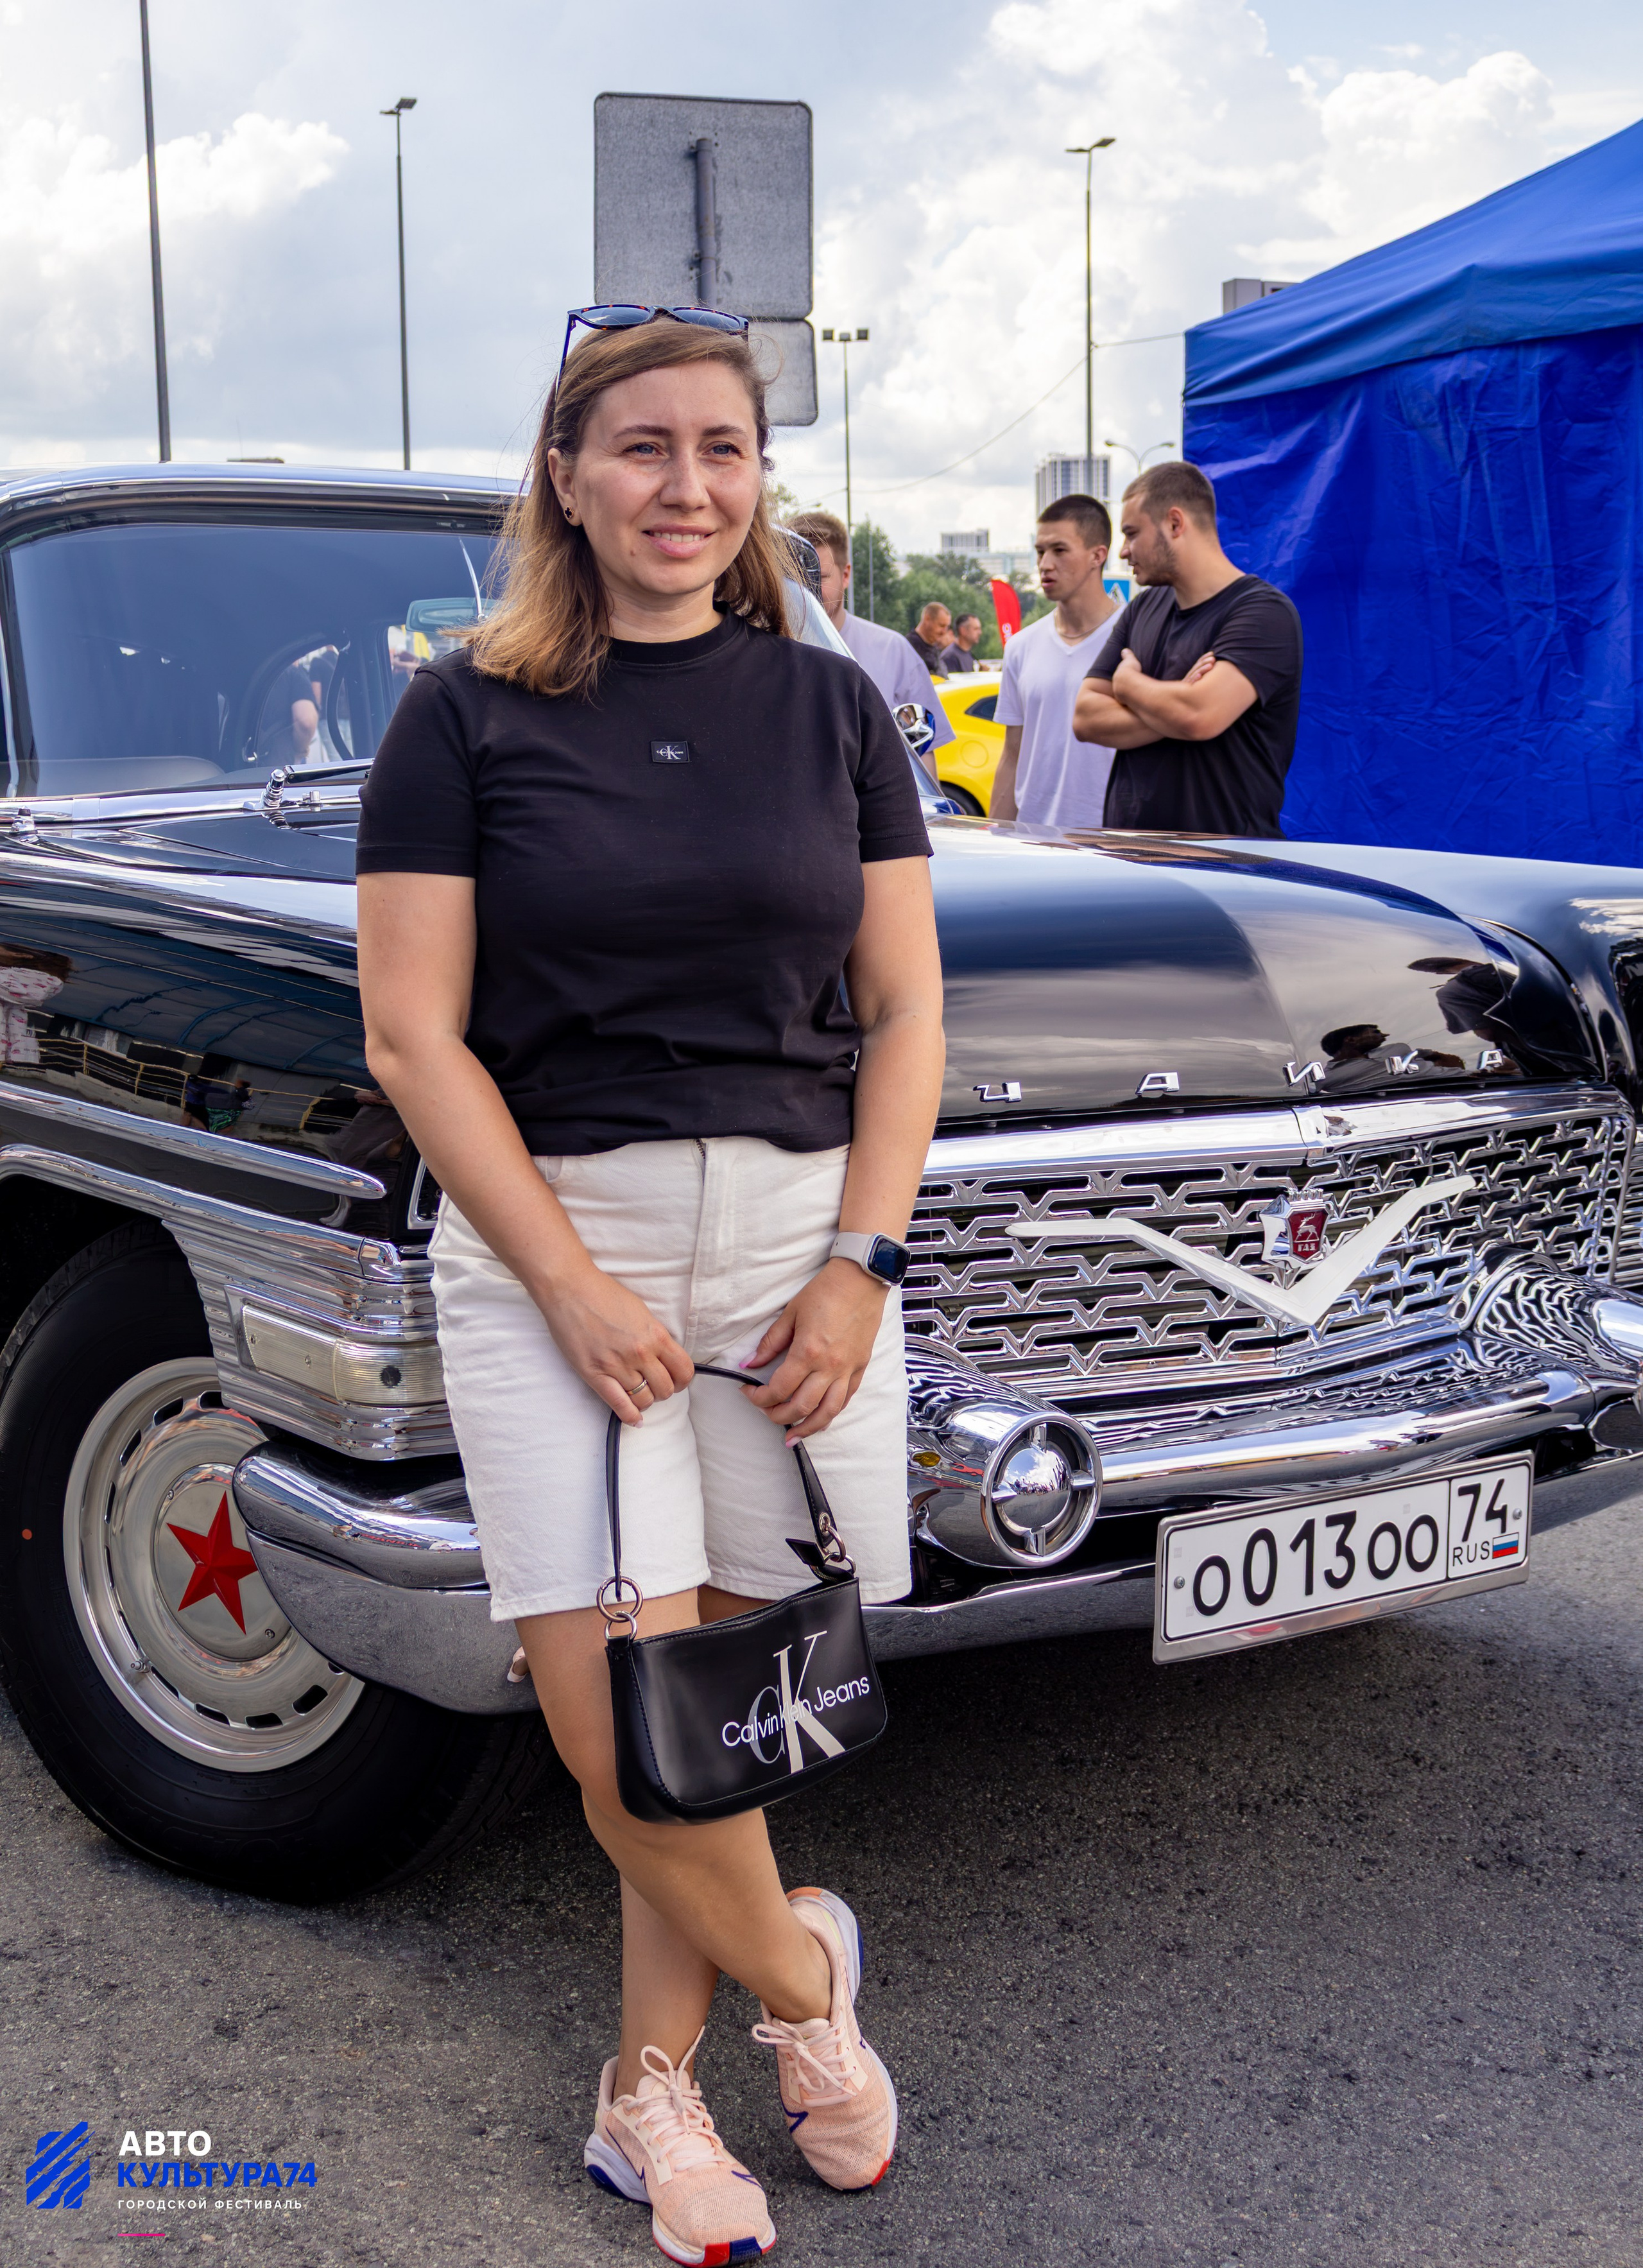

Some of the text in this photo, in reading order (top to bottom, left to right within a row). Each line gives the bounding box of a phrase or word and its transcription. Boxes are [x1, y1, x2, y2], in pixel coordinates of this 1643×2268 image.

[1297, 1243, 1315, 1252] ГАЗ
[1458, 1478, 1508, 1543] 74
[1452, 1541, 1490, 1566] RUS
[721, 1708, 779, 1747] Calvin
[814, 1676, 870, 1712] Jeans
